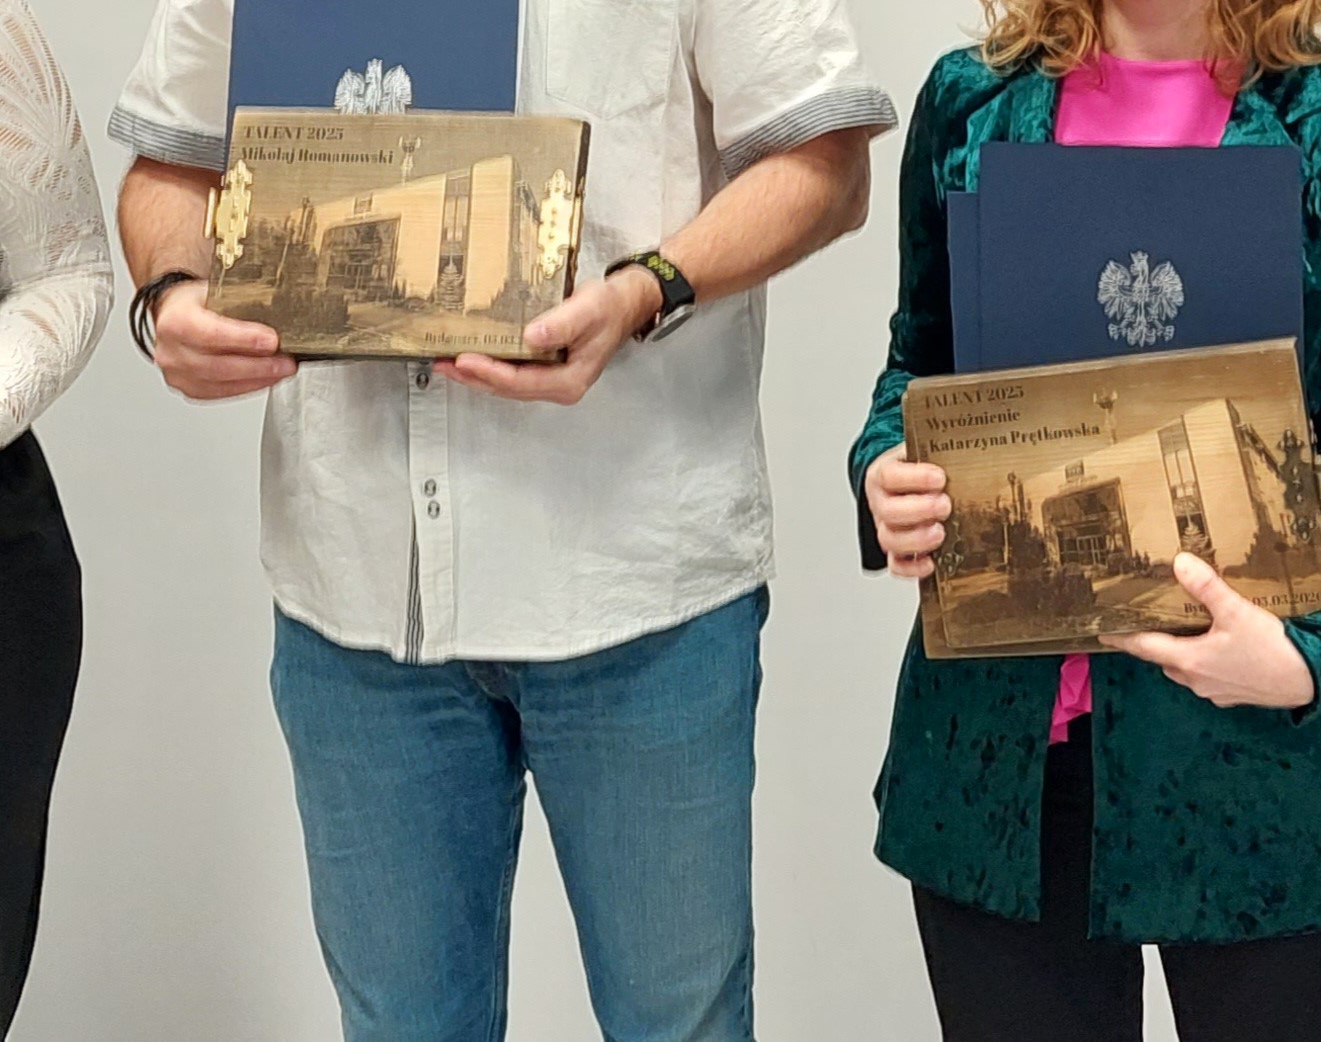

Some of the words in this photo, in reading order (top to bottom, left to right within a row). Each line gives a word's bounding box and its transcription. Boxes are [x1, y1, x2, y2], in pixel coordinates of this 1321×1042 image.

[243, 125, 303, 140] TALENT
[307, 127, 344, 141] 2025
[298, 148, 394, 164] Romanowski
[924, 389, 982, 408] TALENT
[986, 385, 1024, 401] 2025
[926, 409, 1021, 433] Wyróżnienie
[929, 434, 1008, 453] Katarzyna
[1010, 422, 1101, 446] Prętkowska
